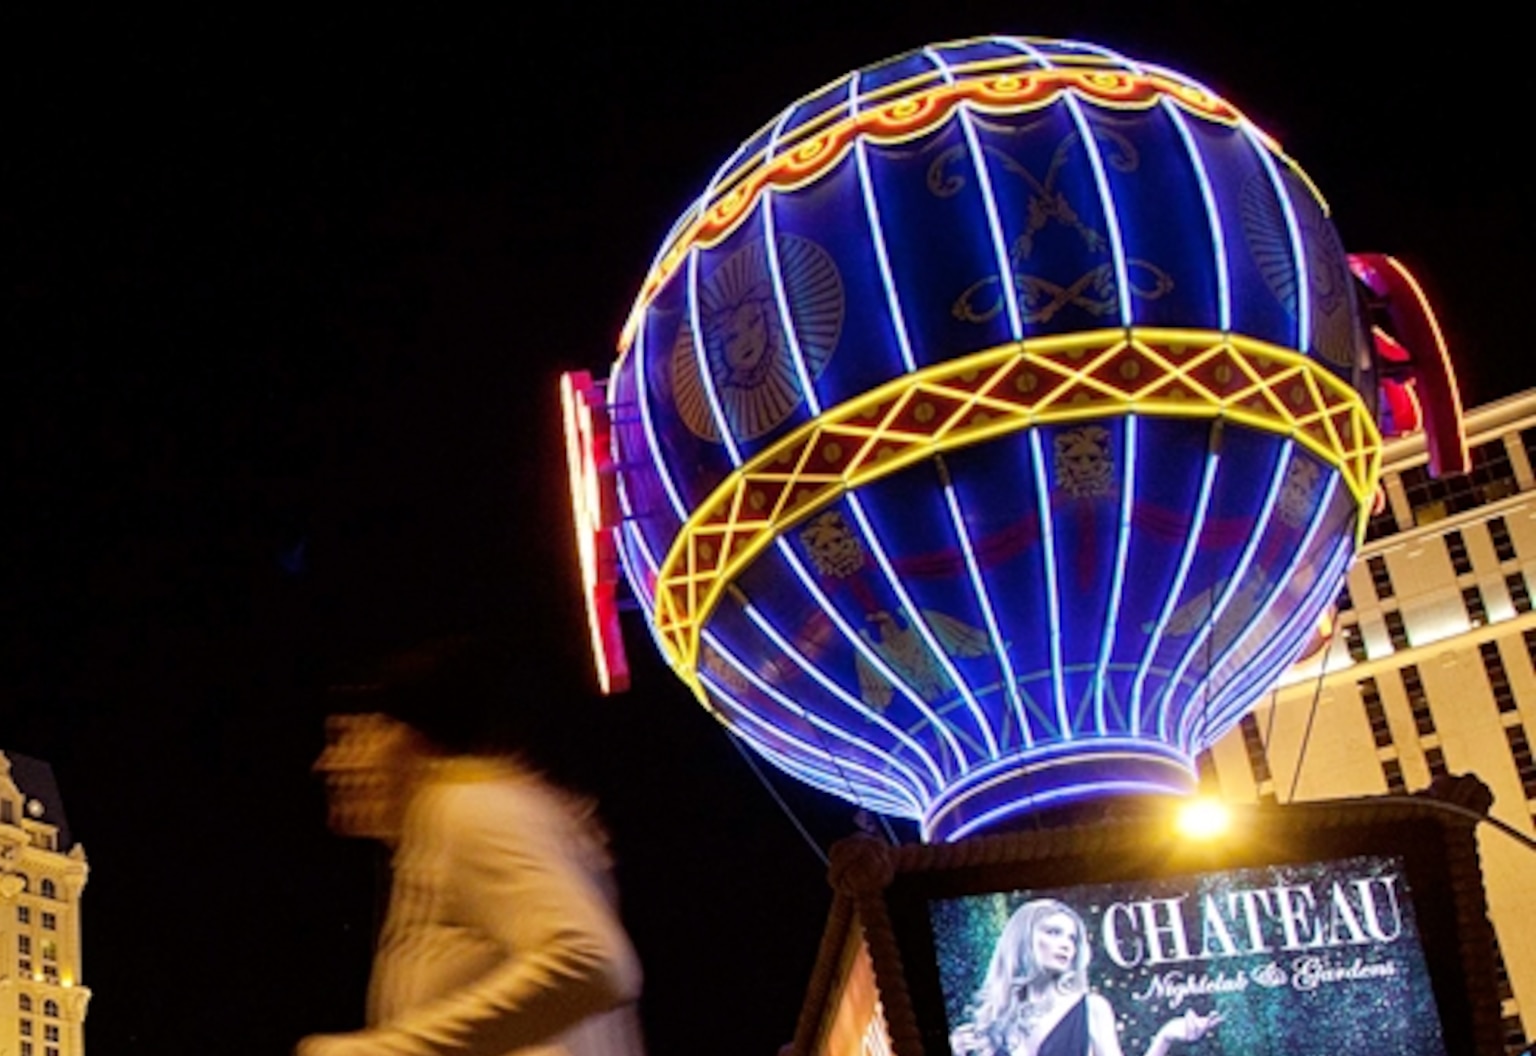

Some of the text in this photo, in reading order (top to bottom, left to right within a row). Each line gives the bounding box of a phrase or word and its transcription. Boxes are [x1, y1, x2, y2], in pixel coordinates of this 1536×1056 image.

[1102, 874, 1402, 969] CHATEAU
[1132, 956, 1396, 1009] Nightclub & Gardens
